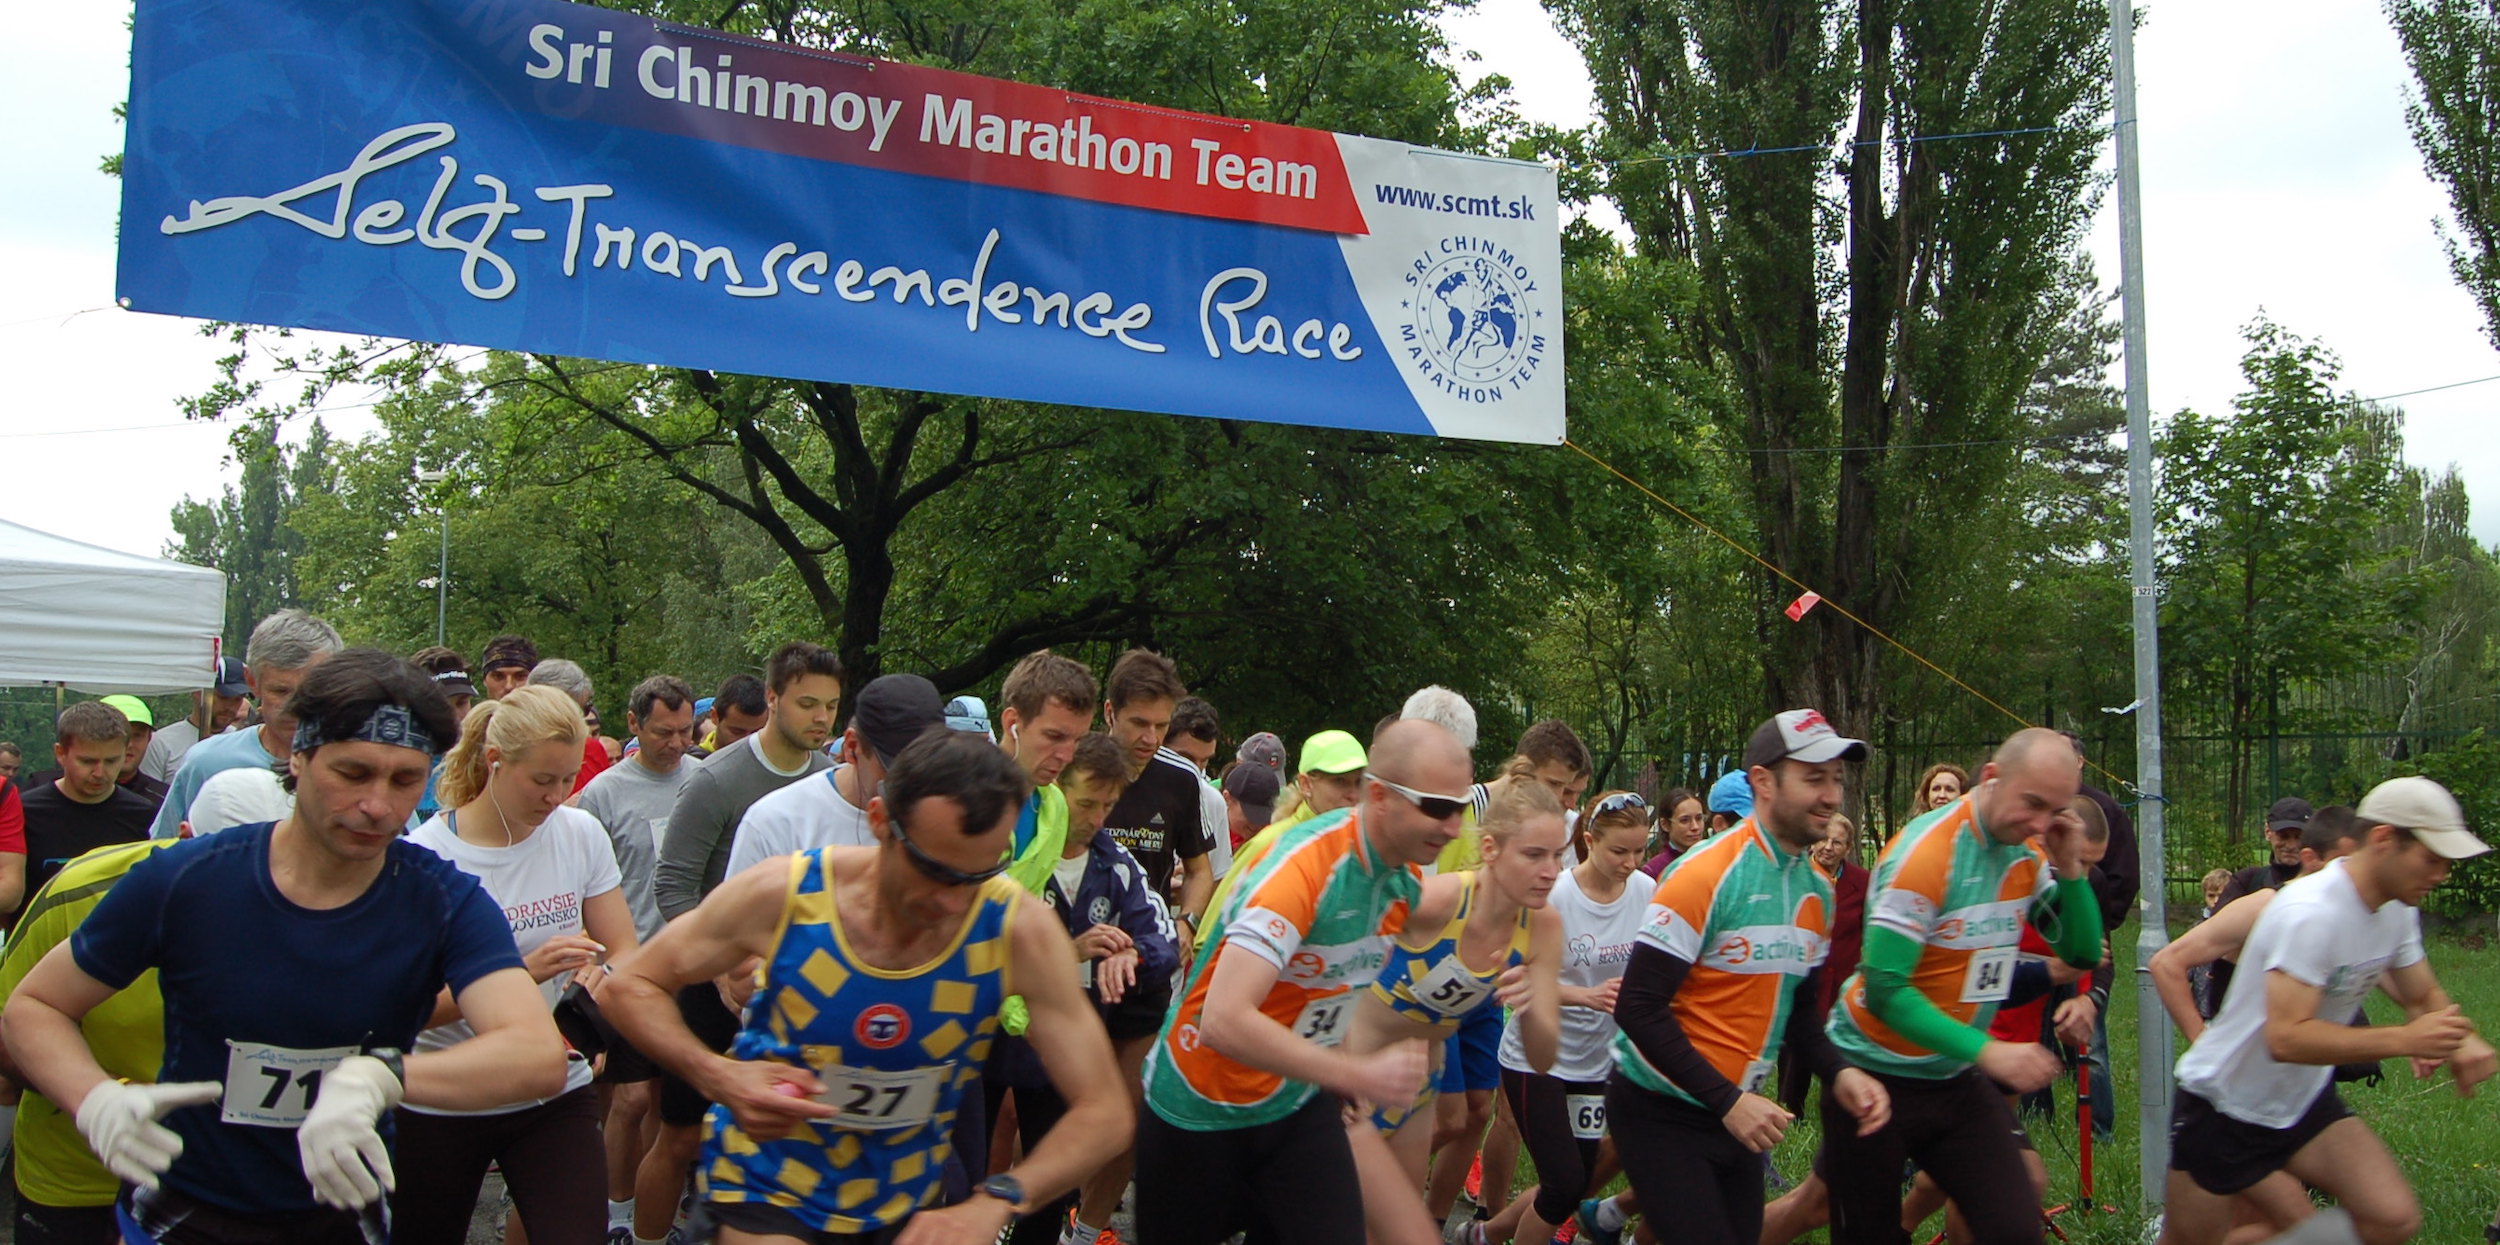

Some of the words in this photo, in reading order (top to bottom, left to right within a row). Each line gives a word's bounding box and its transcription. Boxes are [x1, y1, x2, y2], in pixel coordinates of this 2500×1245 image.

[526, 24, 613, 88] Sri
[638, 45, 902, 151] Chinmoy
[919, 94, 1173, 180] Marathon
[1191, 139, 1317, 199] Team
[1375, 184, 1535, 221] www.scmt.sk
[1405, 251, 1433, 287] SRI
[1440, 236, 1538, 294] CHINMOY
[1200, 267, 1361, 360] Race
[1400, 323, 1502, 404] MARATHON
[1509, 334, 1546, 391] TEAM
[505, 892, 577, 921] DRAVŠIE
[512, 906, 579, 933] OVENSKO
[1598, 942, 1634, 956] ZDRAV
[1598, 953, 1632, 965] SLOVE
[1431, 977, 1476, 1008] 51
[1303, 1005, 1343, 1039] 34
[259, 1065, 323, 1111] 71
[841, 1083, 911, 1116] 27
[1578, 1105, 1605, 1129] 69
